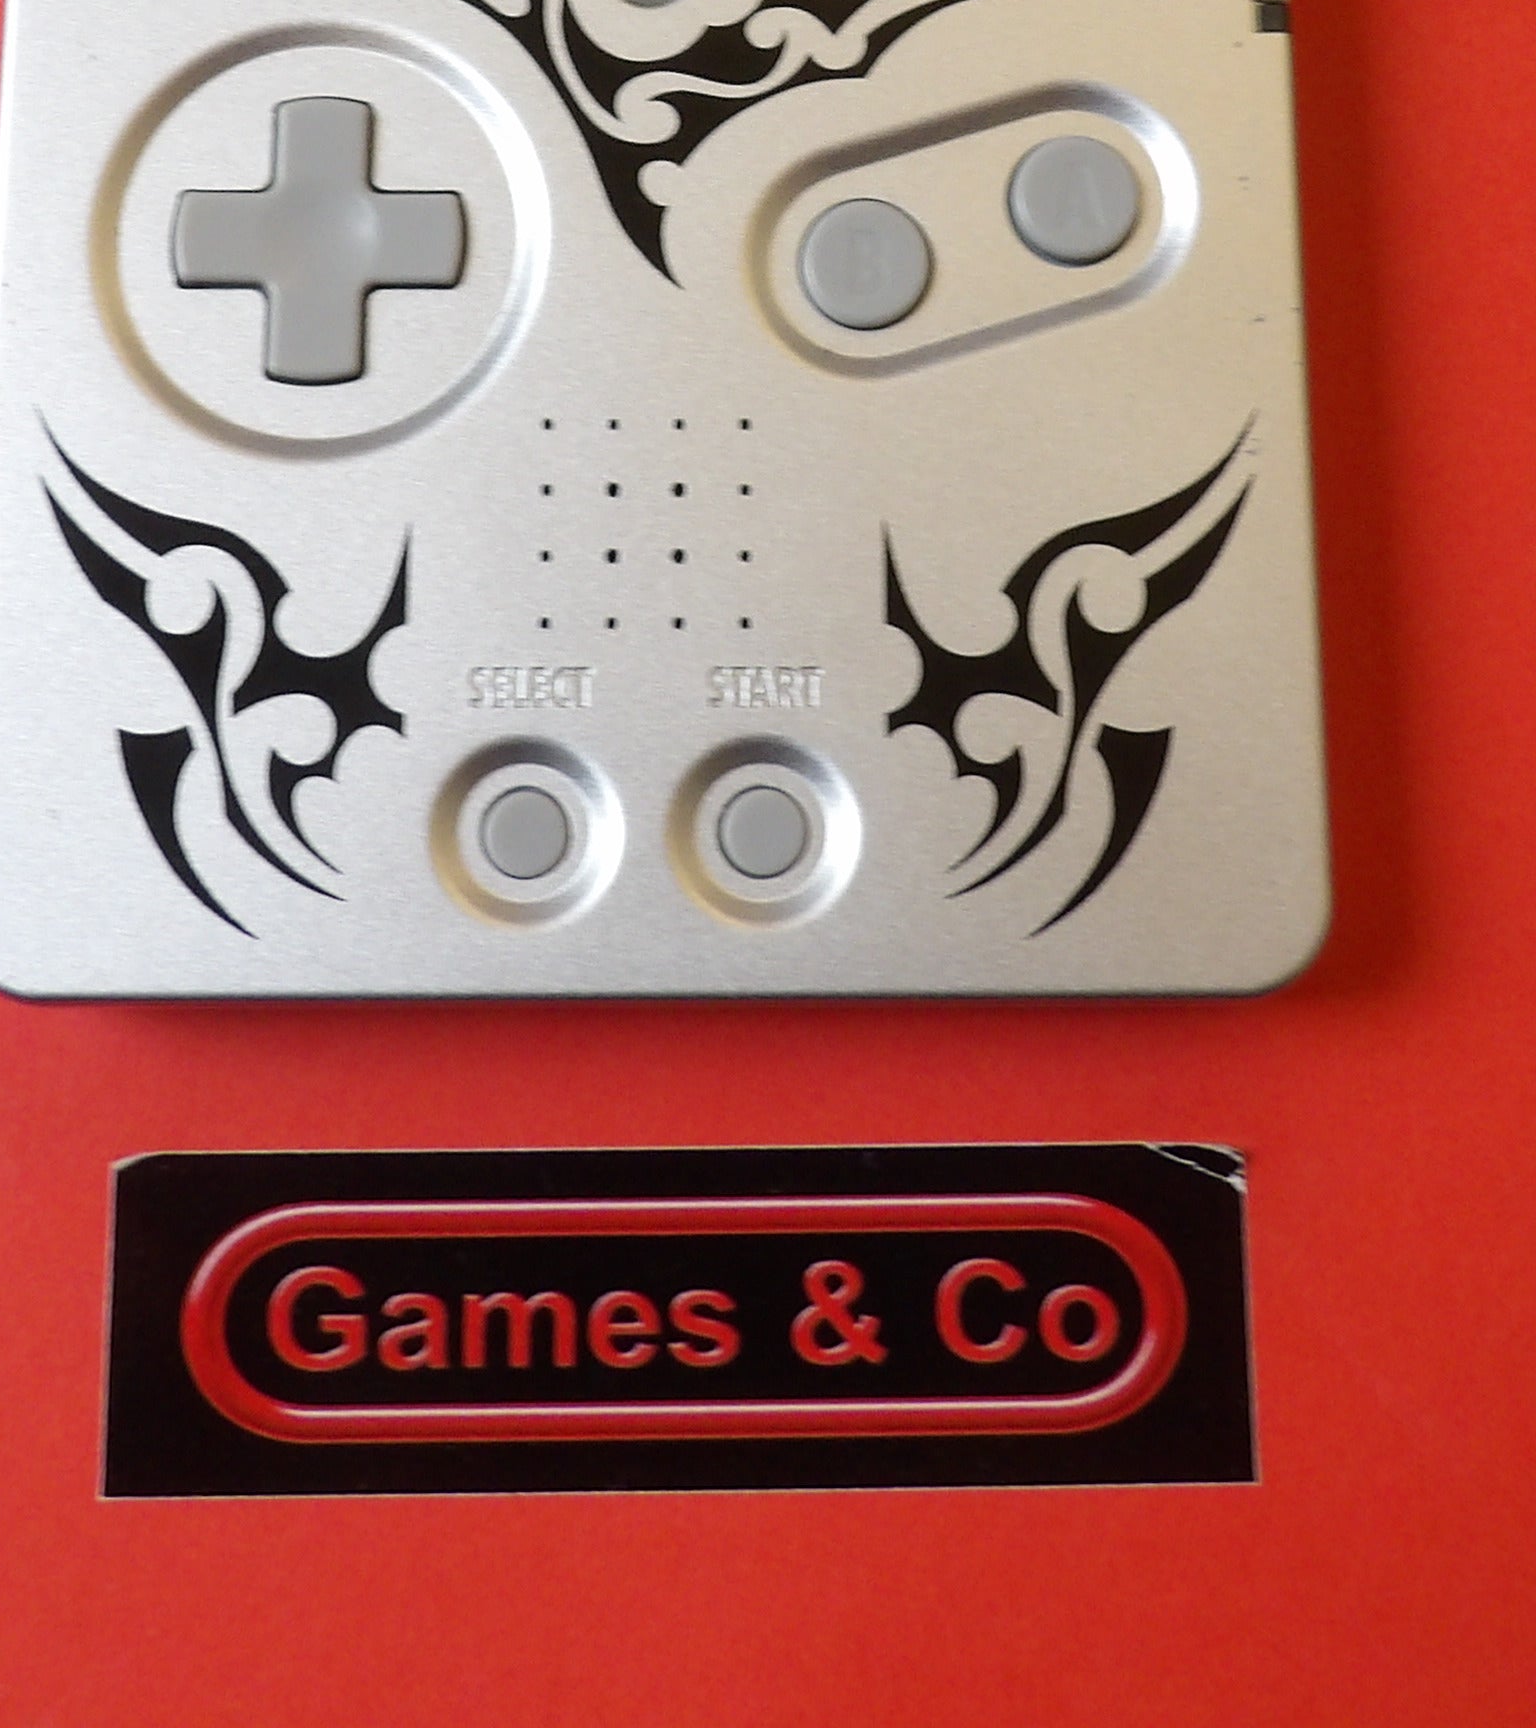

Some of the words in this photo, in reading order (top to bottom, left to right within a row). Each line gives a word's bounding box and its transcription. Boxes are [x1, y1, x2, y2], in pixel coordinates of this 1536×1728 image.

[1051, 158, 1107, 230] A
[843, 226, 894, 296] B
[466, 665, 597, 709] SELECT
[707, 665, 826, 709] START
[266, 1264, 741, 1374] Games
[789, 1258, 888, 1367] &
[934, 1256, 1121, 1364] Co
